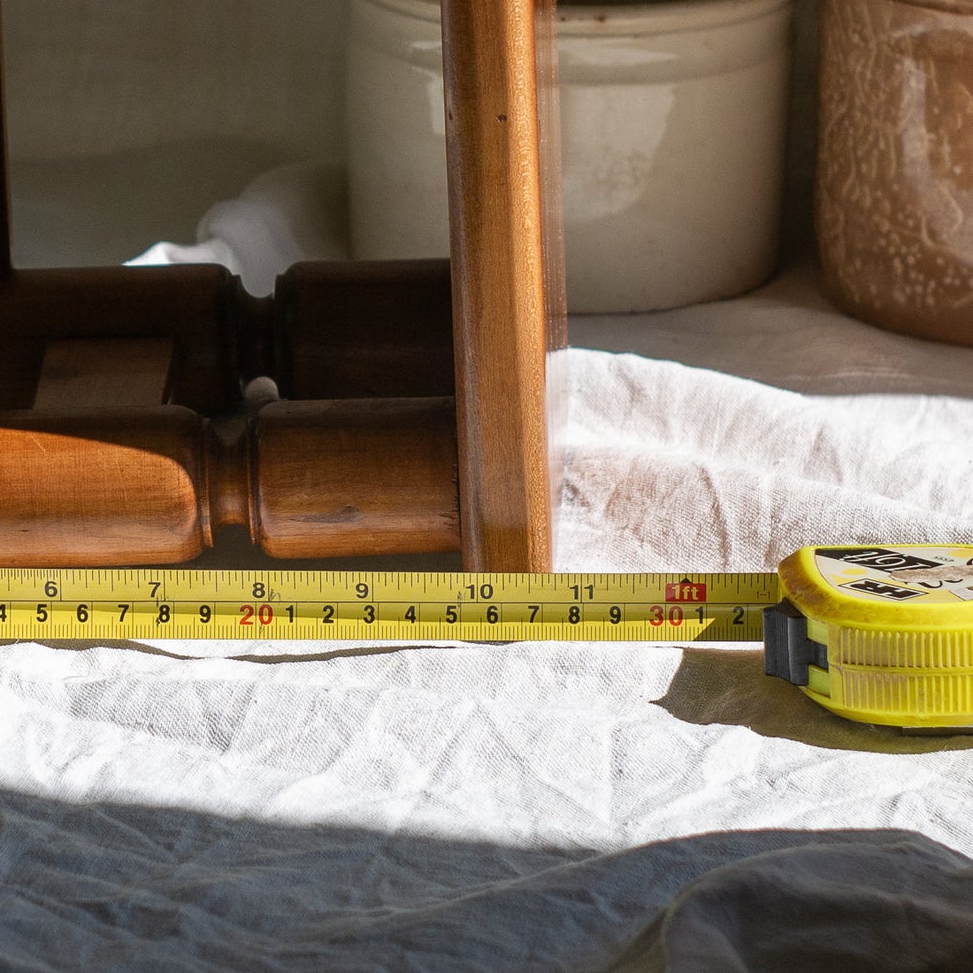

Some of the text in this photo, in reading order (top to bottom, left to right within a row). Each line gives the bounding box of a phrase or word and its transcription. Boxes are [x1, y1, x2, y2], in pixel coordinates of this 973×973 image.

[840, 551, 931, 572] 16ft
[44, 581, 58, 598] 6
[148, 582, 161, 598] 7
[252, 582, 266, 599] 8
[355, 583, 369, 599] 9
[465, 584, 494, 600] 10
[569, 584, 594, 600] 11
[672, 585, 699, 601] 1ft
[36, 604, 48, 622] 5
[76, 604, 89, 623] 6
[117, 604, 129, 623] 7
[158, 604, 171, 623] 8
[199, 605, 211, 624] 9
[239, 604, 274, 626] 20
[285, 605, 294, 623] 1
[322, 605, 334, 624] 2
[363, 605, 375, 624] 3
[404, 605, 416, 624] 4
[445, 605, 457, 624] 5
[486, 605, 498, 624] 6
[527, 605, 540, 624] 7
[568, 605, 580, 625] 8
[609, 605, 621, 625] 9
[649, 606, 683, 627] 30
[695, 606, 704, 624] 1
[732, 606, 745, 625] 2
